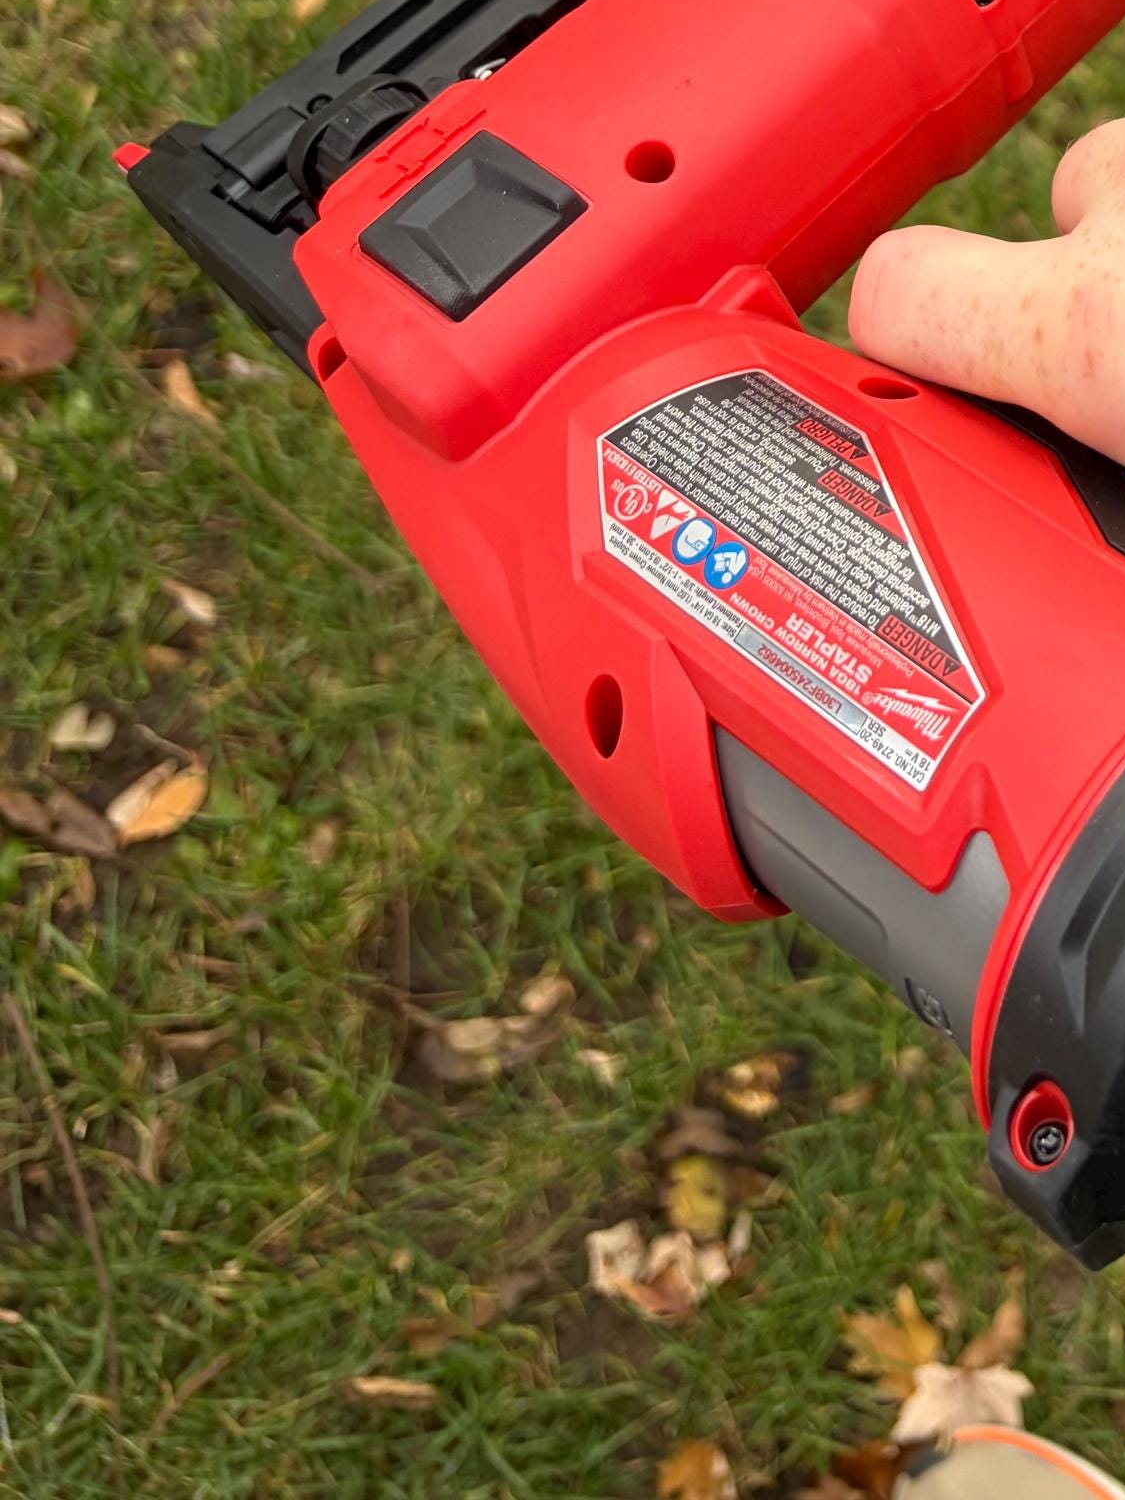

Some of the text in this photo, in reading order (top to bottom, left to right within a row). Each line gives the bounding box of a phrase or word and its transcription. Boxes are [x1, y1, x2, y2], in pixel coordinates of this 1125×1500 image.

[693, 392, 711, 408] use.
[706, 402, 719, 415] in
[635, 414, 661, 437] avoid
[651, 409, 683, 437] manual
[714, 407, 731, 423] not
[726, 415, 738, 428] is
[761, 411, 773, 423] le
[769, 416, 785, 432] lire
[629, 426, 649, 445] Use
[656, 429, 668, 442] to
[719, 396, 827, 475] Pour minimiser les risques de
[732, 419, 752, 438] tool
[747, 429, 761, 442] or
[780, 424, 799, 441] doit
[799, 415, 852, 456] PELIGRO
[662, 434, 701, 466] fasteners
[676, 427, 706, 453] Check
[617, 434, 659, 469] Operators
[654, 461, 687, 490] manual.
[671, 456, 692, 477] side
[687, 467, 707, 487] with
[695, 454, 728, 484] driving
[737, 469, 748, 482] is
[631, 468, 661, 494] LISTED
[662, 401, 915, 582] for triggering options. Never point tool at yourself or others in the work
[687, 403, 910, 560] area. Remove battery pack when clearing jammed fasteners,
[721, 474, 738, 492] not
[743, 473, 777, 502] method
[820, 468, 877, 513] DANGER
[703, 477, 738, 508] glasses
[734, 484, 759, 507] when
[719, 508, 742, 529] read
[730, 496, 762, 525] safety
[755, 496, 787, 525] trigger
[771, 491, 814, 527] triggering
[738, 521, 762, 542] must
[756, 516, 779, 536] wear
[780, 517, 803, 539] from
[806, 518, 820, 533] of
[607, 534, 630, 555] Staples
[758, 535, 779, 554] user
[775, 530, 800, 553] must
[800, 528, 827, 552] away
[814, 524, 847, 552] Choice
[627, 550, 647, 569] Crown
[637, 543, 650, 556] mm
[775, 546, 805, 574] injury,
[796, 544, 818, 564] area
[819, 542, 854, 573] fingers
[798, 565, 812, 580] of
[813, 558, 838, 581] work
[843, 542, 890, 581] discharge.
[644, 563, 667, 584] Narrow
[807, 571, 828, 591] risk
[833, 572, 846, 587] in
[847, 563, 876, 589] Keep
[822, 583, 840, 601] the
[842, 578, 873, 606] others
[871, 581, 915, 617] batteries.
[883, 572, 930, 611] accidental
[702, 608, 714, 620] GA
[752, 554, 916, 677] Professionally made in Vietnam by Milwaukee Tool
[836, 592, 870, 623] reduce
[868, 597, 890, 618] and
[711, 614, 722, 626] 18
[719, 620, 737, 638] Size:
[865, 613, 881, 630] To
[728, 590, 863, 696] 18GA NARROW CROWN
[783, 611, 874, 685] STAPLER
[843, 634, 884, 668] Milwaukee
[880, 616, 945, 670] DANGER
[864, 716, 886, 737] SER.
[858, 727, 894, 759] 2749-20
[917, 756, 931, 771] 18
